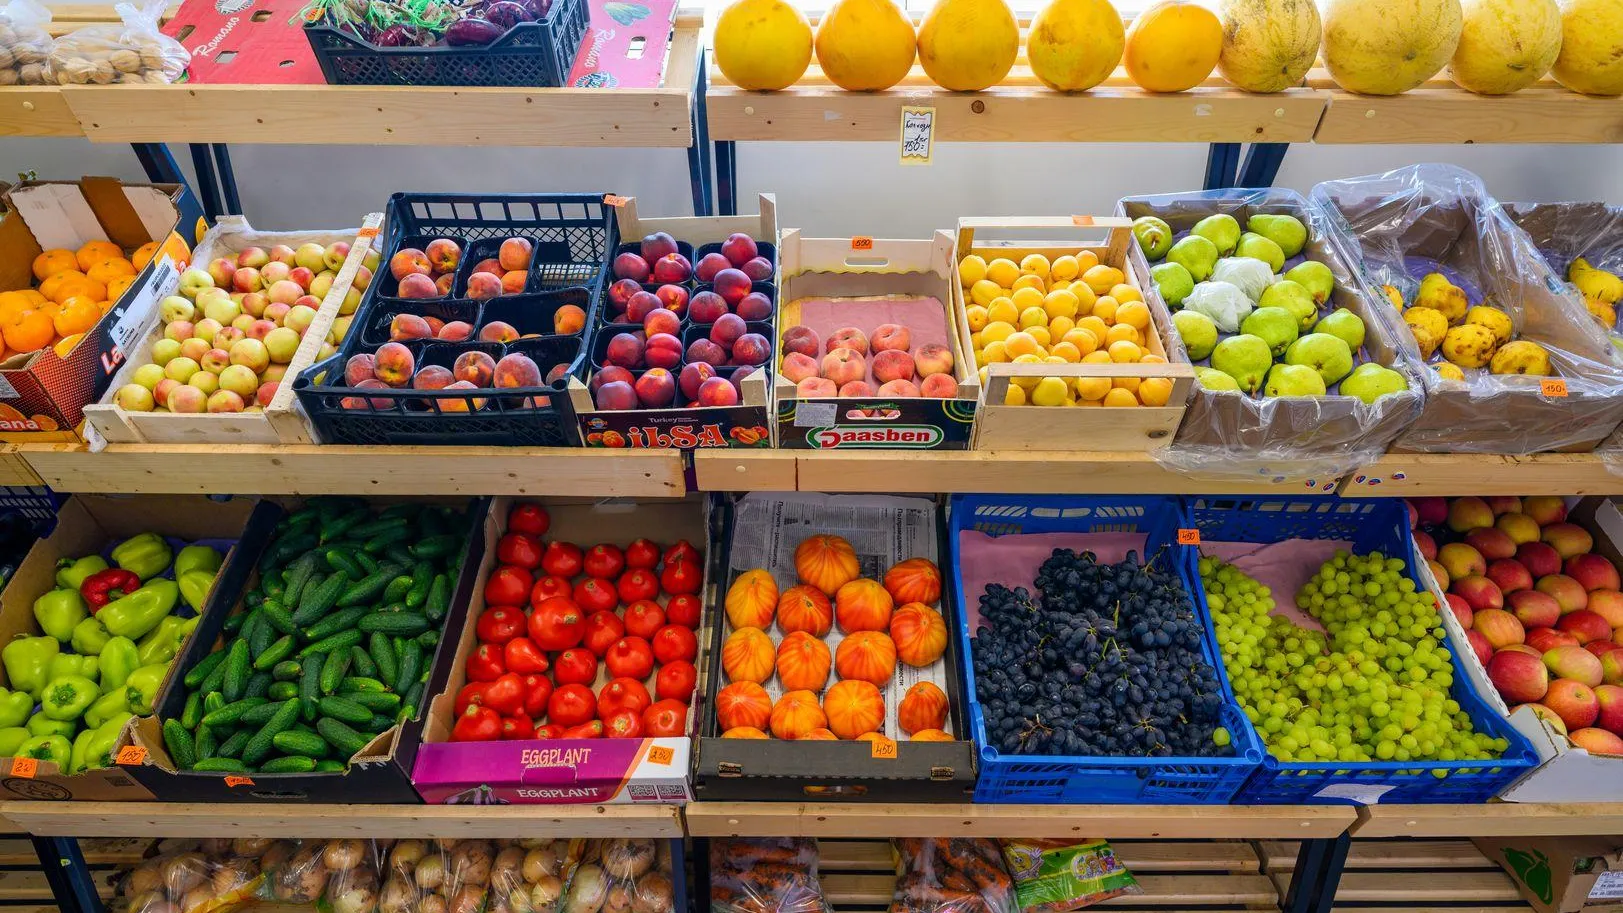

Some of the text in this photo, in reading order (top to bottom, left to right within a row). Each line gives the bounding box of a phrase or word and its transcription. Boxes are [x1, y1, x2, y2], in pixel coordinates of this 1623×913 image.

[192, 17, 240, 57] Romano
[520, 748, 592, 765] EGGPLANT
[517, 787, 599, 799] EGGPLANT
